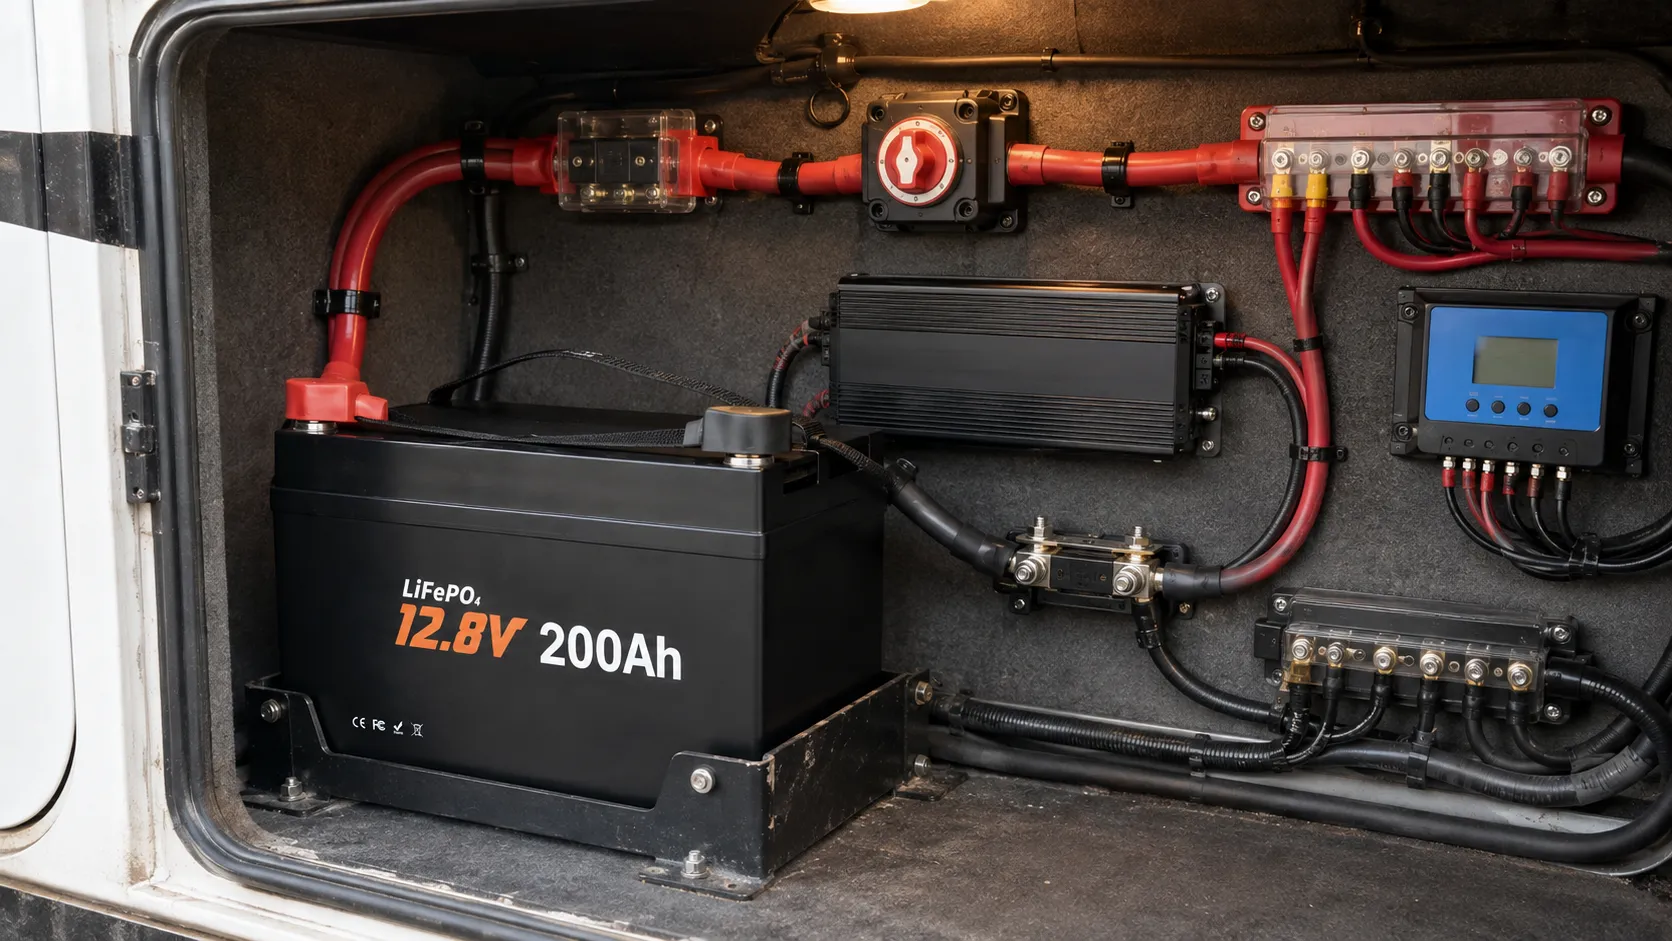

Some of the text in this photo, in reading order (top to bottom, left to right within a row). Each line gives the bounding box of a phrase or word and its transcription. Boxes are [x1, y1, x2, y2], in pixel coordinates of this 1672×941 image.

[395, 603, 682, 681] 12.8V 200Ah
[352, 716, 366, 729] CE
